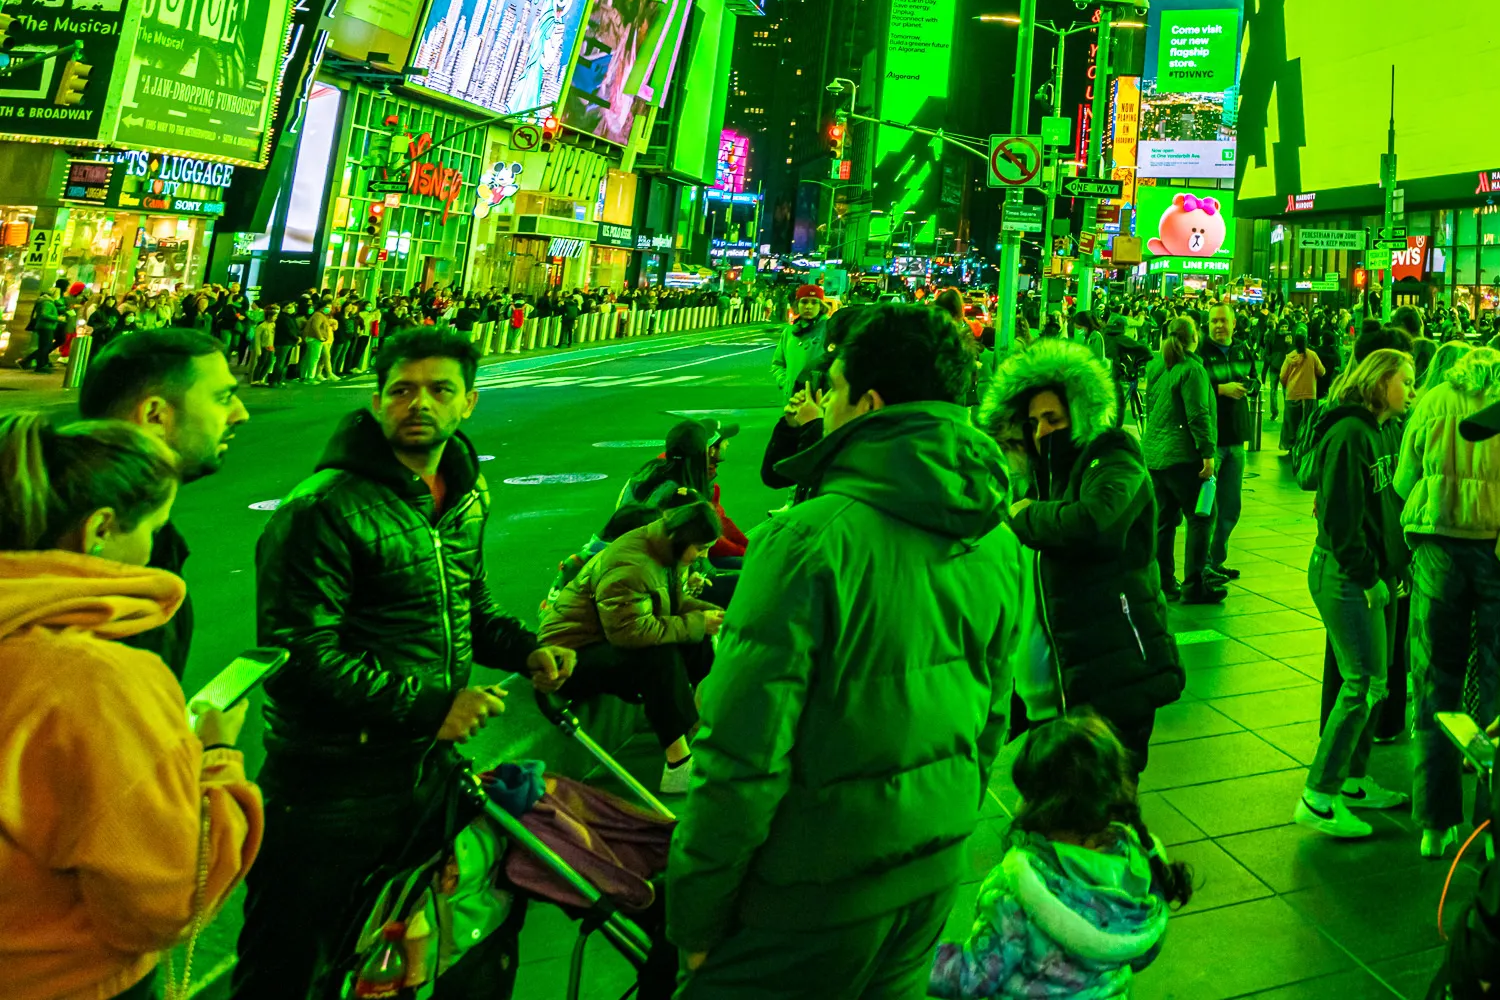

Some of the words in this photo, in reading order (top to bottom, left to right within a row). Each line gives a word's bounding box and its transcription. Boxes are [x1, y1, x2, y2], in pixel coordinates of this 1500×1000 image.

[17, 14, 49, 32] The
[138, 26, 154, 43] The
[1171, 25, 1200, 35] Come
[1201, 24, 1223, 34] visit
[1170, 38, 1188, 46] our
[1188, 37, 1210, 46] new
[1169, 47, 1210, 59] flagship
[1168, 60, 1197, 68] store.
[885, 70, 920, 80] Algorand
[1168, 70, 1215, 79] #TD1VNYC
[151, 75, 215, 108] JAW-DROPPING
[1121, 103, 1135, 113] NOW
[16, 107, 26, 118] &
[29, 107, 94, 120] BROADWAY
[1117, 113, 1137, 123] PLAYING
[1122, 124, 1130, 135] ON
[159, 155, 235, 188] LUGGAGE
[1070, 183, 1088, 192] ONE
[1096, 184, 1116, 193] WAY
[1295, 192, 1317, 202] MARRIOTT
[174, 199, 201, 212] SONY
[1295, 201, 1314, 210] MARQUIS
[1301, 231, 1331, 239] PEDESTRIAN
[30, 232, 46, 263] ATM
[1182, 260, 1202, 270] LINE
